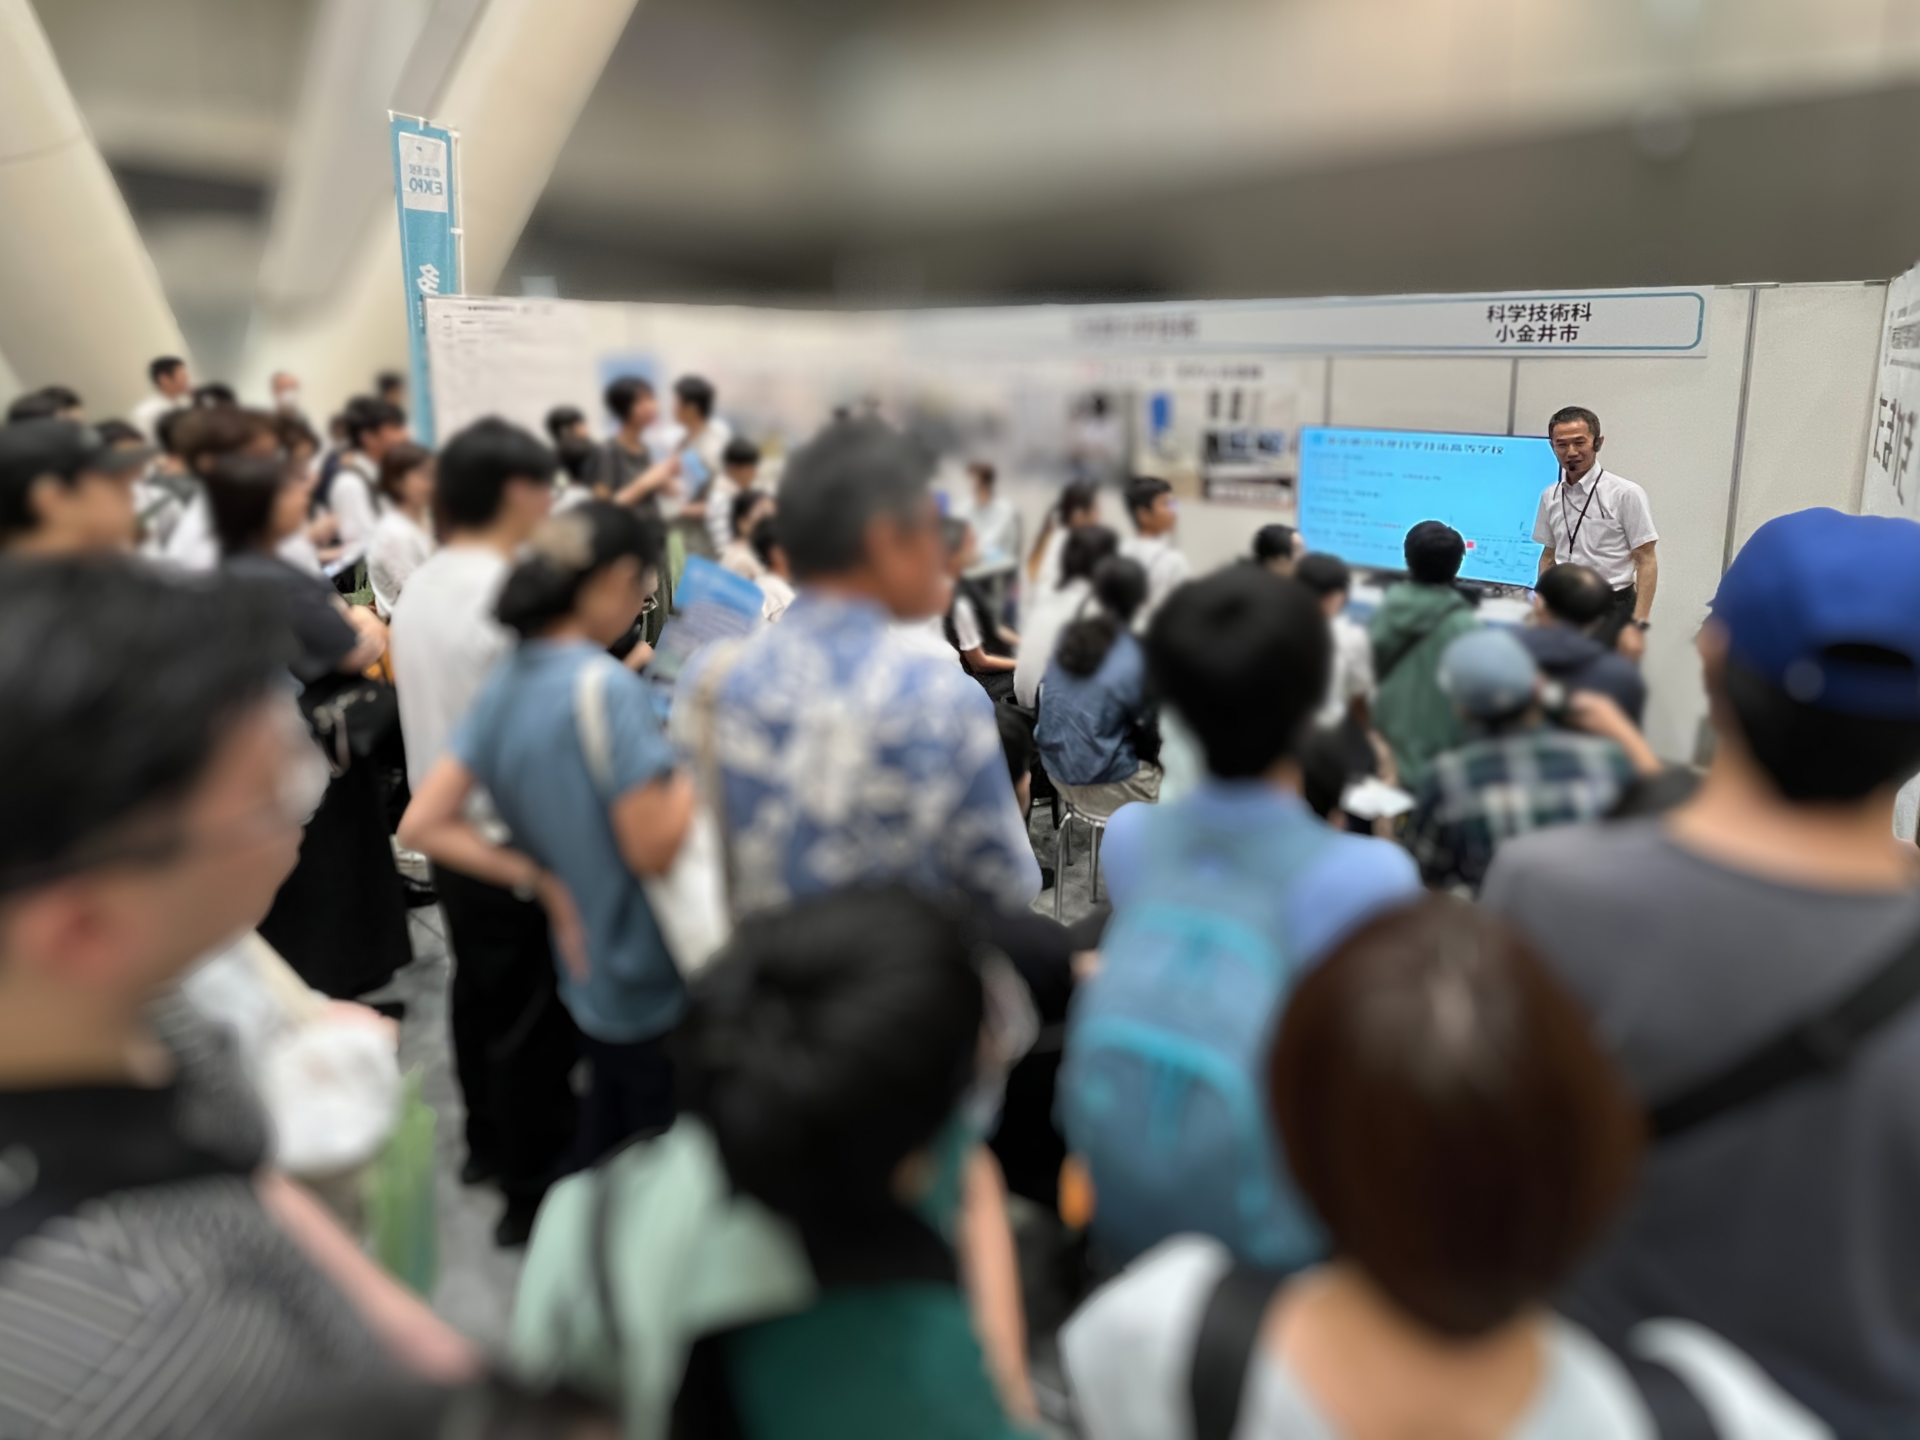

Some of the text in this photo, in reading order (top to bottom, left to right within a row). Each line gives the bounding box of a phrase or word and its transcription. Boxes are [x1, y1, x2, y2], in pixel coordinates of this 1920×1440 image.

[1486, 302, 1592, 322] 科学技術科
[1495, 324, 1580, 343] 小金井市
